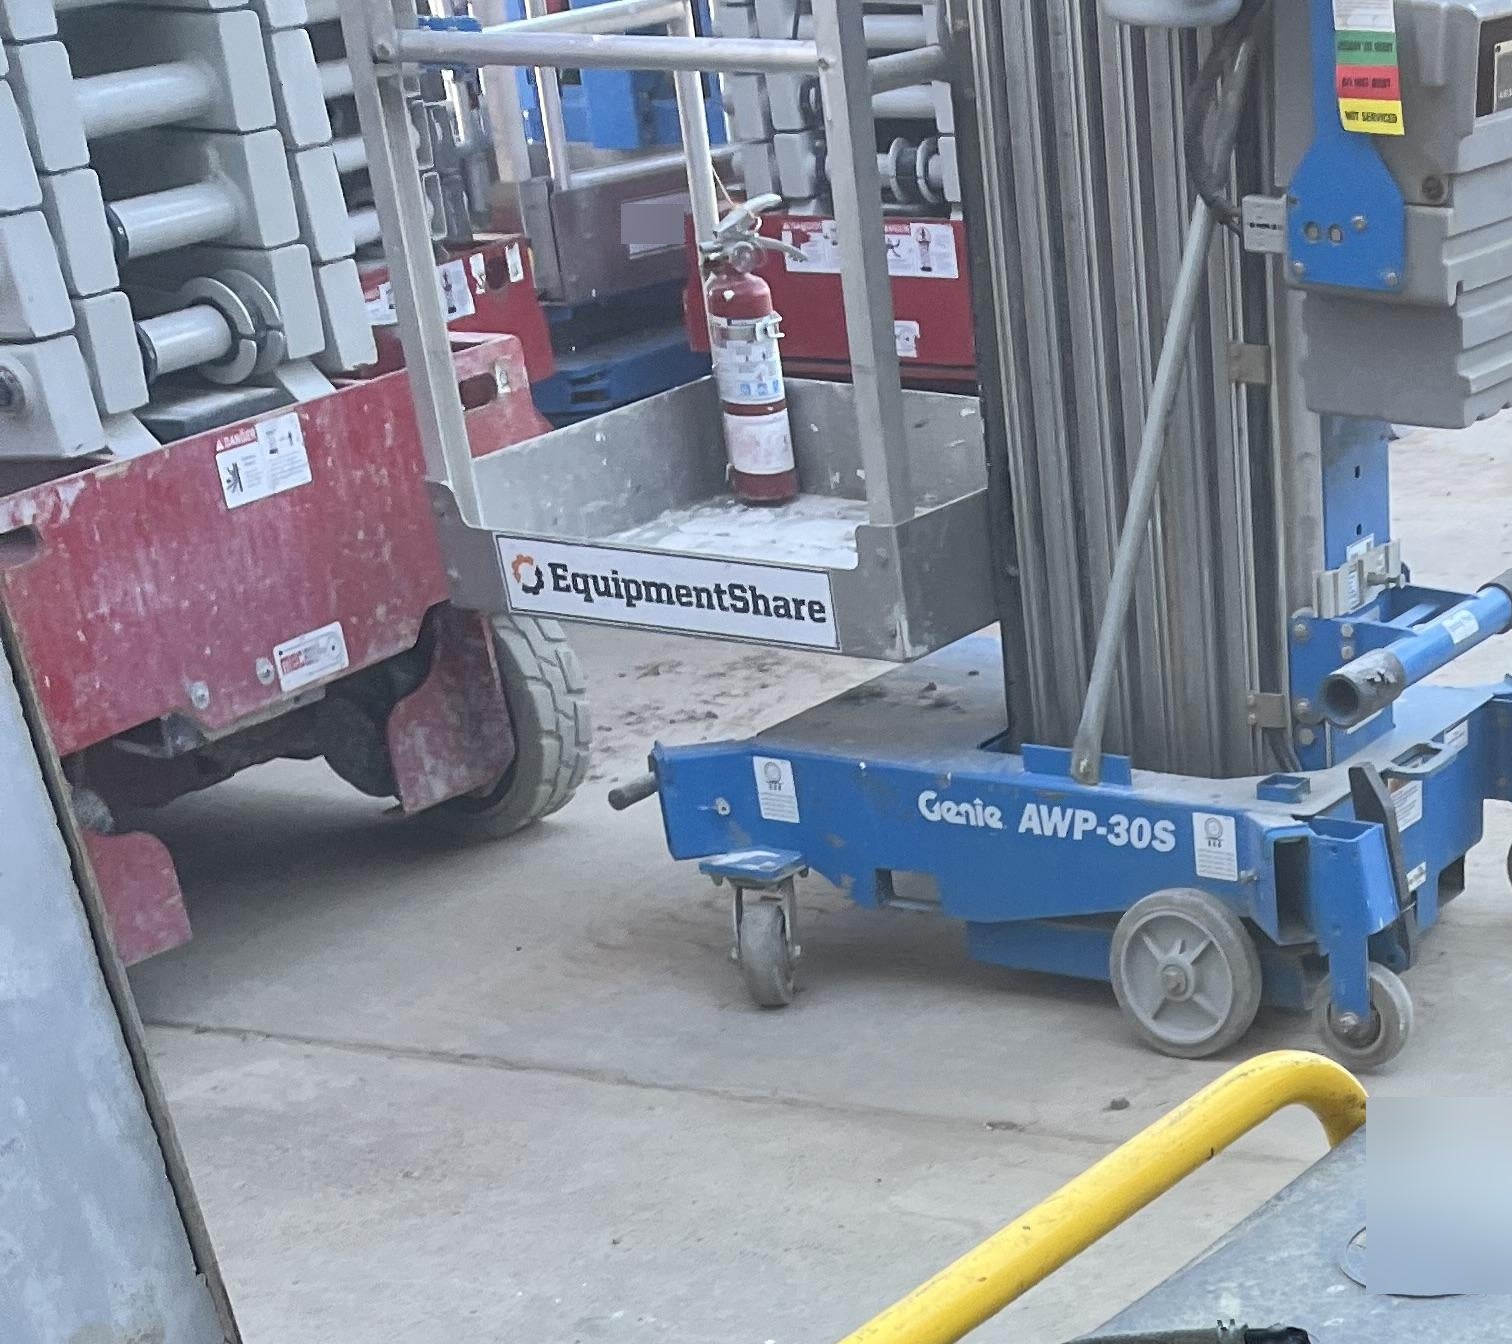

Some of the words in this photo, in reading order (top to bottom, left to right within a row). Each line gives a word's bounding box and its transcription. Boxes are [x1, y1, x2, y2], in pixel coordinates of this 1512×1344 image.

[548, 562, 826, 624] EquipmentShare
[918, 790, 1004, 830] Genie
[1018, 803, 1176, 853] AWP-30S
